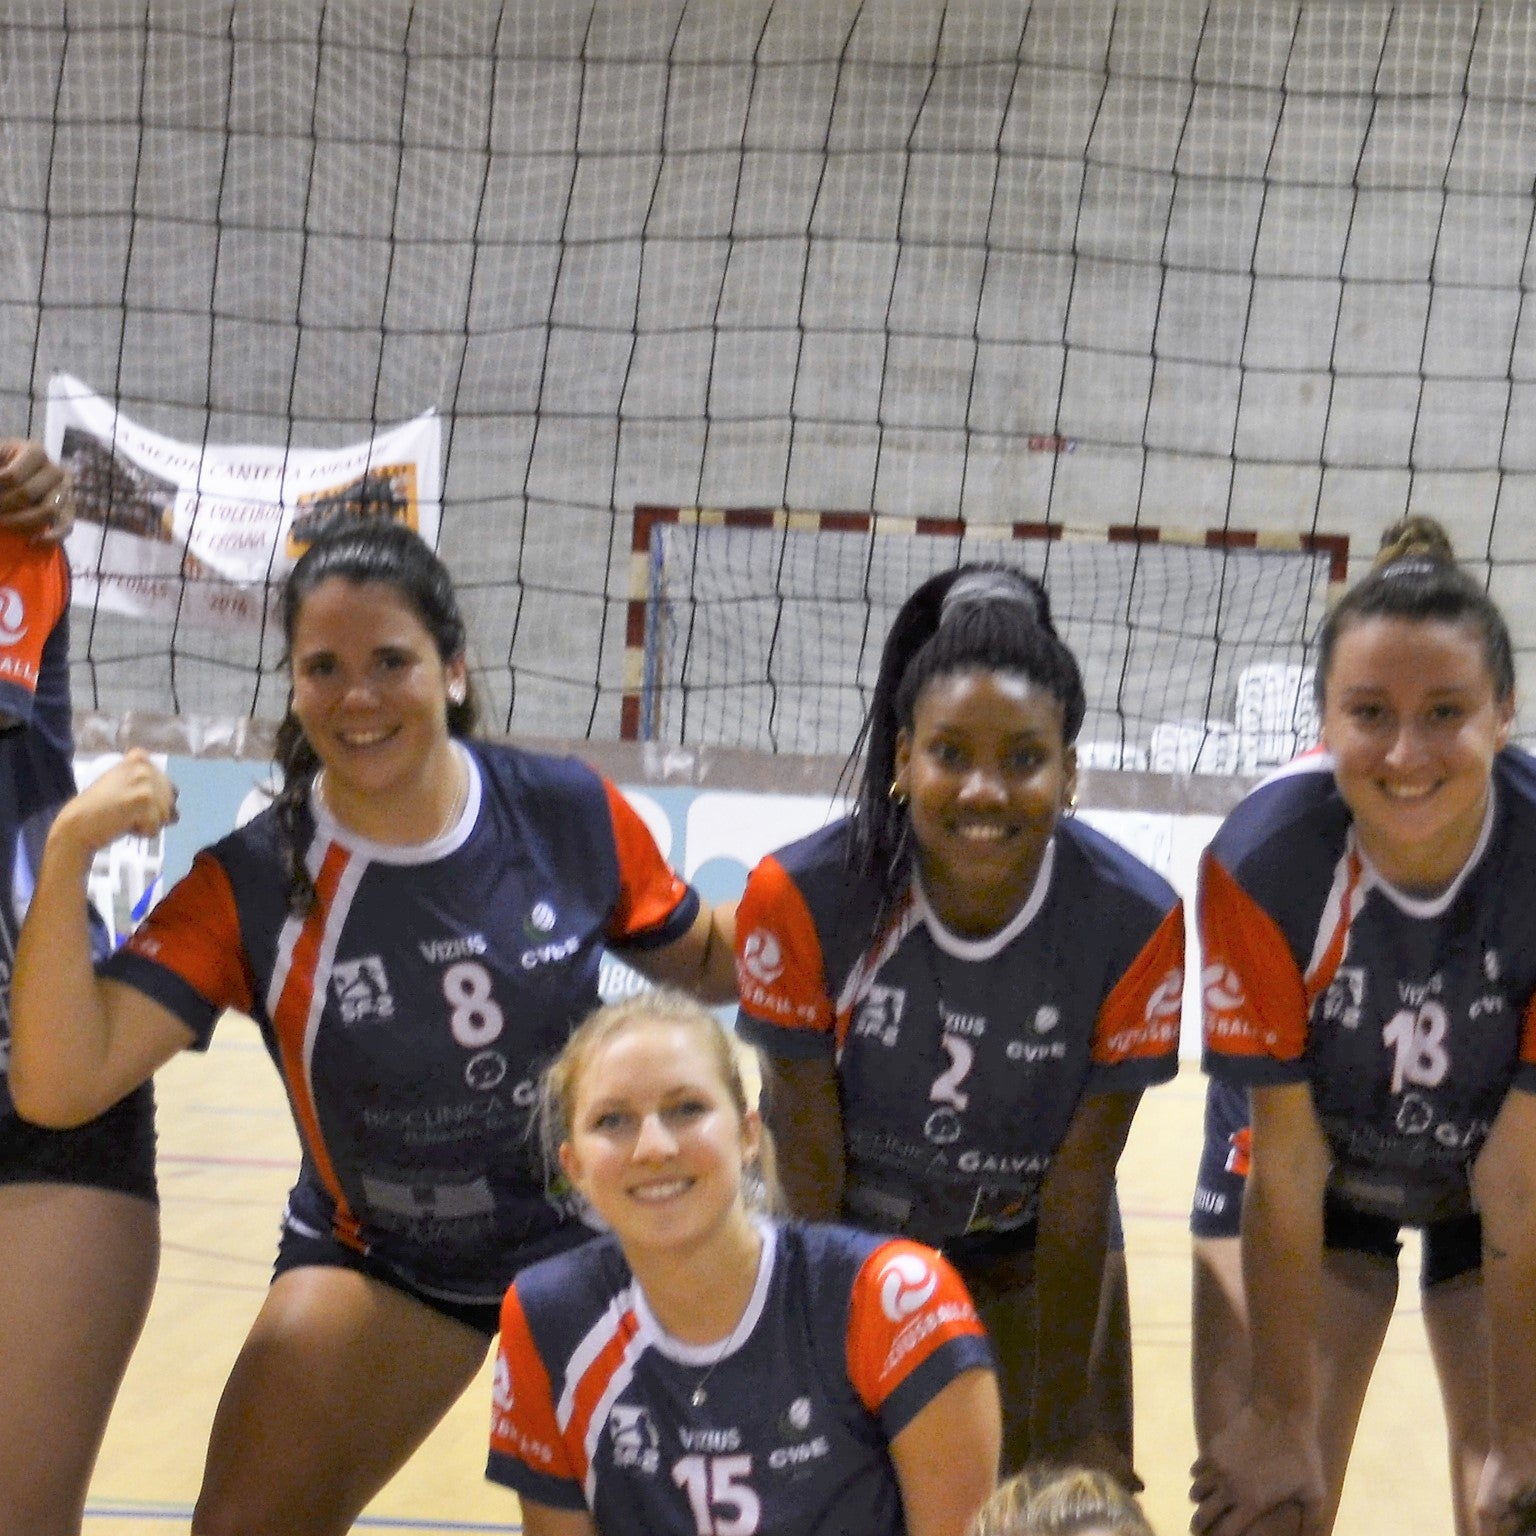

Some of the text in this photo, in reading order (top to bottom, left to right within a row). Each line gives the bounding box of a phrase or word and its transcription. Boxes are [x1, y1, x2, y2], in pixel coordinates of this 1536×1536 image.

[442, 961, 505, 1049] 8
[1382, 1000, 1450, 1095] 18
[930, 1032, 974, 1114] 2
